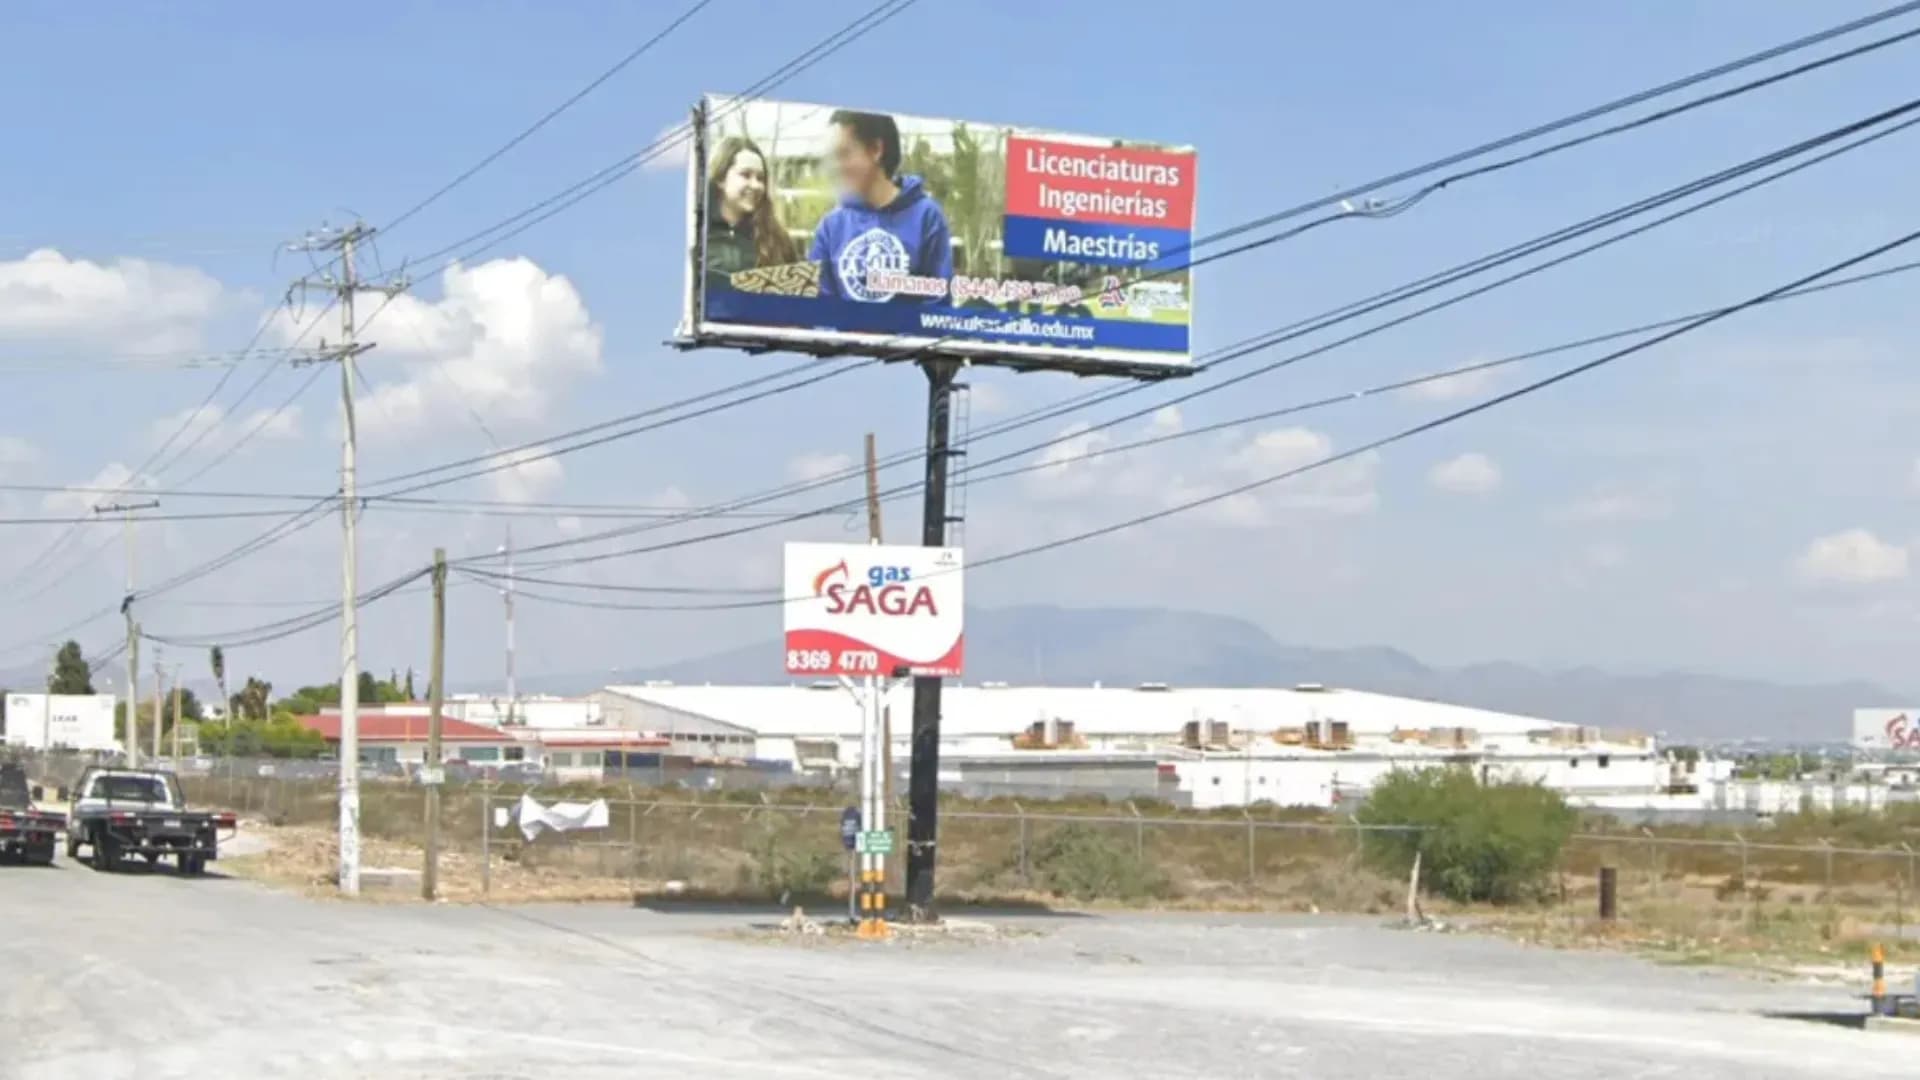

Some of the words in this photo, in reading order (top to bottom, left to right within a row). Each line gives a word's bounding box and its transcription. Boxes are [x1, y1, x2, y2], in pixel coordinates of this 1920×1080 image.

[1026, 148, 1179, 187] Licenciaturas
[1039, 183, 1168, 219] Ingenierías
[1043, 228, 1159, 261] Maestrías
[867, 565, 911, 587] gas
[826, 583, 938, 616] SAGA
[787, 649, 832, 670] 8369
[838, 649, 879, 670] 4770
